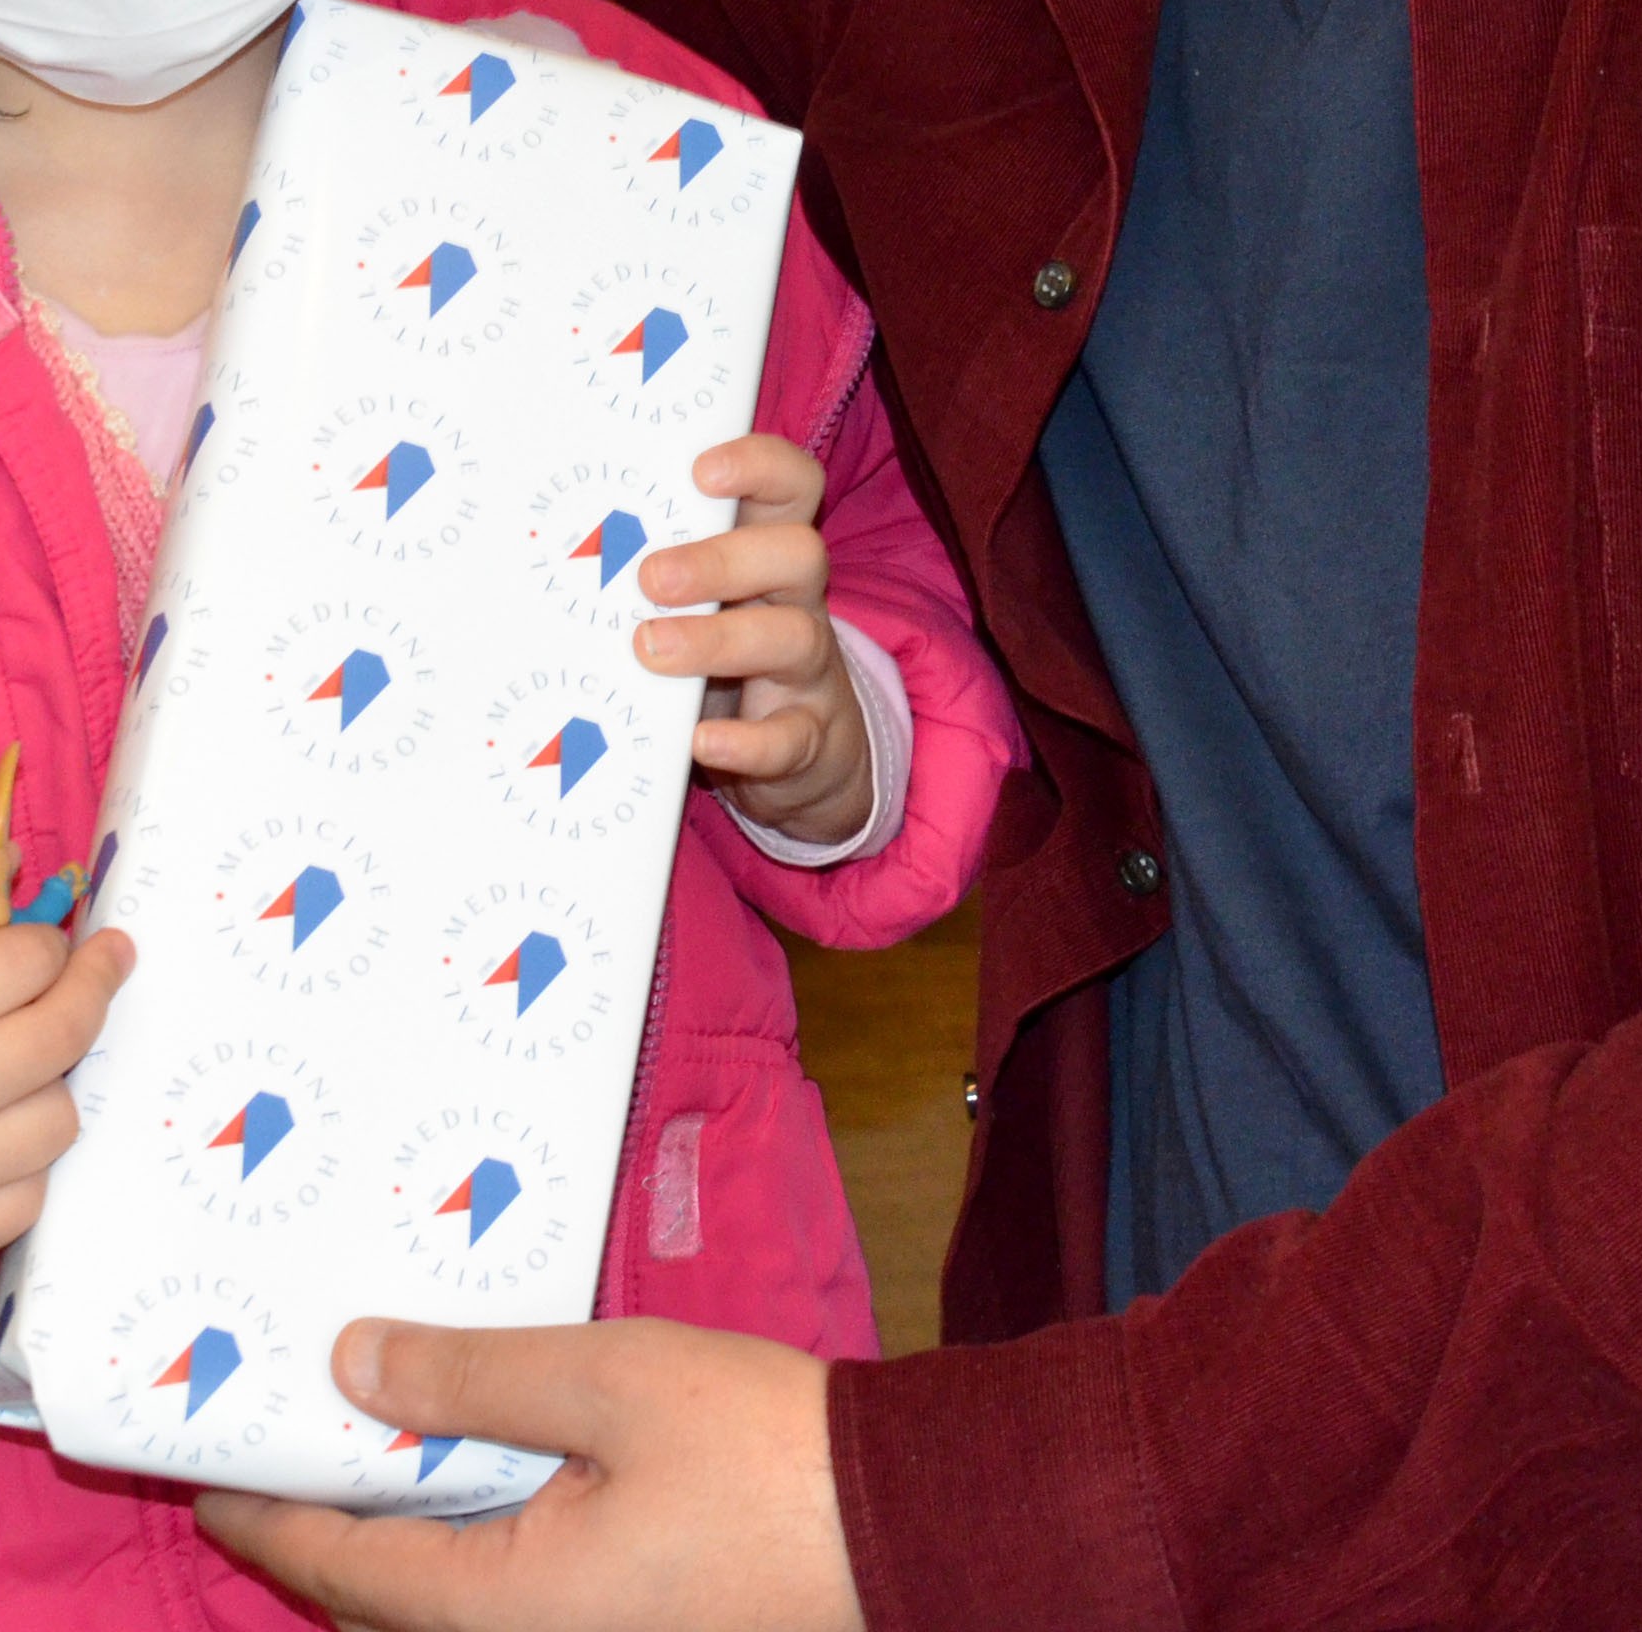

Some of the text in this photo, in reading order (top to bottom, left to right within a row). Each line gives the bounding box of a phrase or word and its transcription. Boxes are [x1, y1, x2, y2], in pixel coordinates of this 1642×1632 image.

[400, 91, 558, 162] HOSPITAL
[612, 156, 766, 227] HOSPITAL
[358, 197, 521, 357] MEDICINE HOSPITAL
[572, 263, 731, 425] MEDICINE HOSPITAL
[312, 395, 479, 561] MEDICINE HOSPITAL
[529, 462, 691, 543] MEDICINE
[265, 600, 435, 774] MEDICINE HOSPITAL
[487, 668, 651, 840] MEDICINE HOSPITAL
[216, 815, 391, 995] MEDICINE HOSPITAL
[442, 881, 612, 1061] MEDICINE HOSPITAL
[164, 1039, 341, 1227] MEDICINE HOSPITAL
[394, 1105, 568, 1292] MEDICINE HOSPITAL
[108, 1273, 291, 1465] MEDICINE HOSPITAL
